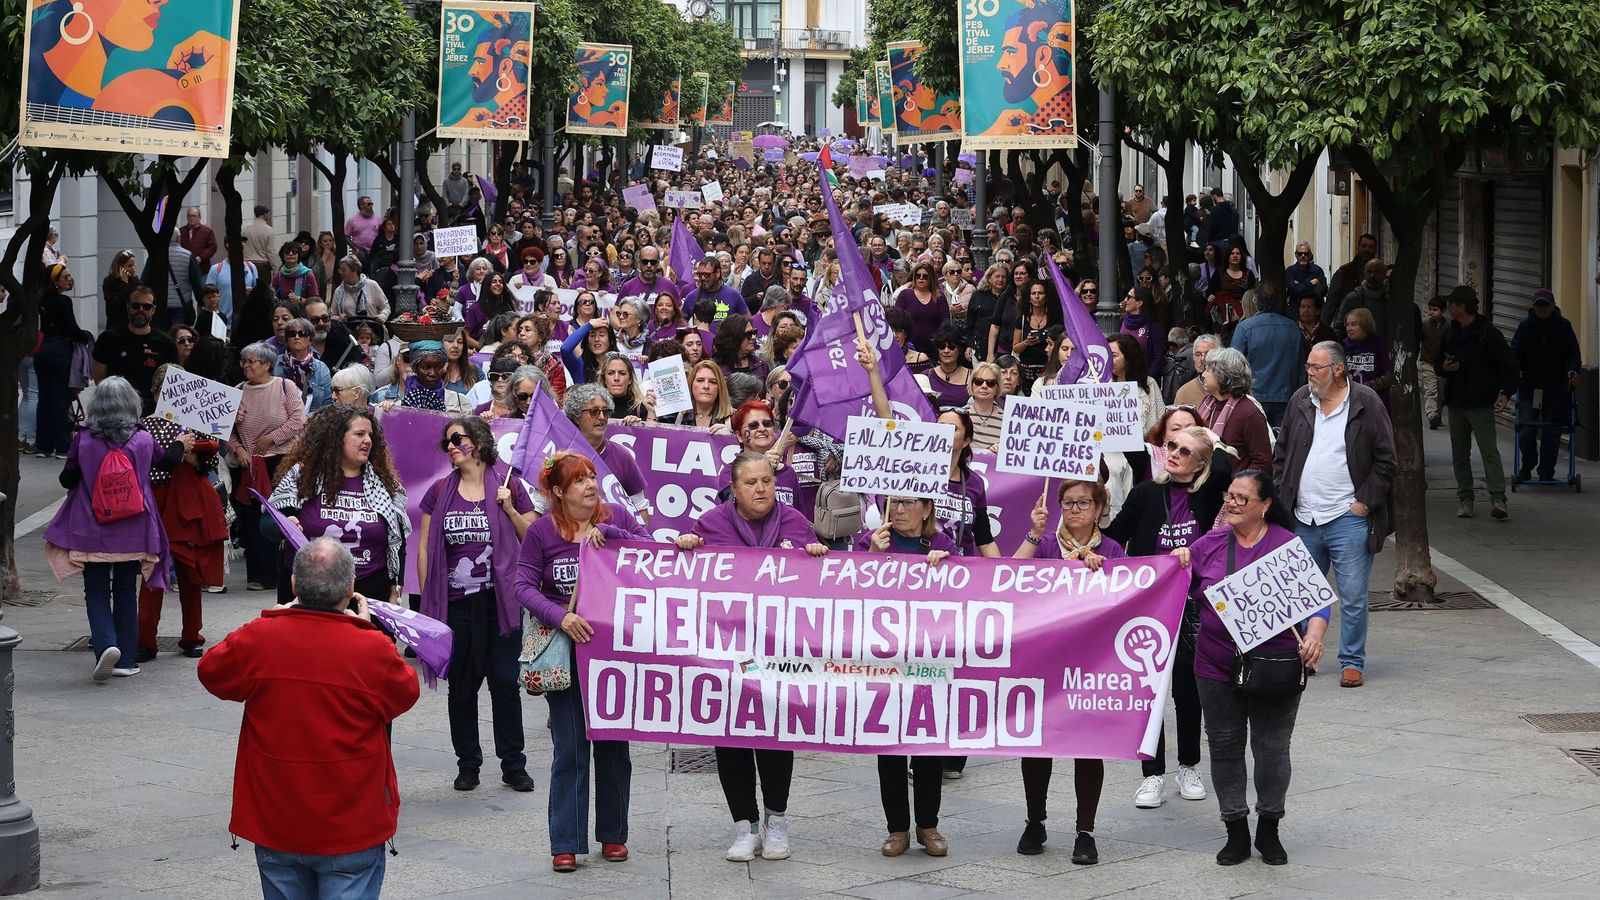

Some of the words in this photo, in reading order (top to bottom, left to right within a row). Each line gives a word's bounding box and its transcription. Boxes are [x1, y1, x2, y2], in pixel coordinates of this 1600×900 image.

[964, 0, 1000, 20] 30
[446, 11, 475, 34] 30
[965, 21, 983, 29] FES
[446, 34, 460, 42] FES
[965, 29, 991, 37] TIVAL
[965, 37, 979, 46] DE
[446, 41, 466, 49] TIVAL
[965, 45, 996, 54] JEREZ
[444, 54, 469, 62] JEREZ
[608, 51, 628, 67] 30
[166, 373, 186, 385] un
[161, 379, 209, 402] MALTRATADO
[194, 388, 211, 399] es
[199, 390, 228, 408] BUEN
[1078, 388, 1091, 399] DE
[1093, 387, 1116, 398] UNA
[197, 400, 236, 425] PADRE
[1124, 398, 1138, 409] UN
[1011, 402, 1071, 425] APARENTA
[1074, 411, 1096, 428] EN
[1105, 411, 1124, 424] QUE
[1127, 411, 1139, 422] LA
[1007, 420, 1022, 435] LA
[1027, 422, 1064, 441] CALLE
[1073, 429, 1091, 443] LO
[1005, 436, 1032, 453] QUE
[1036, 441, 1057, 456] NO
[1061, 443, 1094, 461] ERES
[1004, 453, 1026, 468] EN
[648, 483, 719, 520] OS
[1181, 526, 1193, 535] DE
[615, 546, 736, 583] FRENTE
[753, 554, 800, 586] AL
[819, 557, 971, 595] FASCISMO
[991, 564, 1157, 596] DESATADO
[1215, 581, 1240, 602] TE
[1242, 542, 1307, 588] CANSAS
[1233, 590, 1260, 612] DE
[1233, 573, 1320, 631] NOSOTRAS
[1239, 624, 1262, 646] DE
[1262, 587, 1333, 632] VIVIRLO
[618, 591, 1008, 664] FEMINISMO
[1062, 666, 1133, 691] Marea
[591, 664, 1039, 743] ORGANIZADO
[1067, 693, 1123, 711] Violeta
